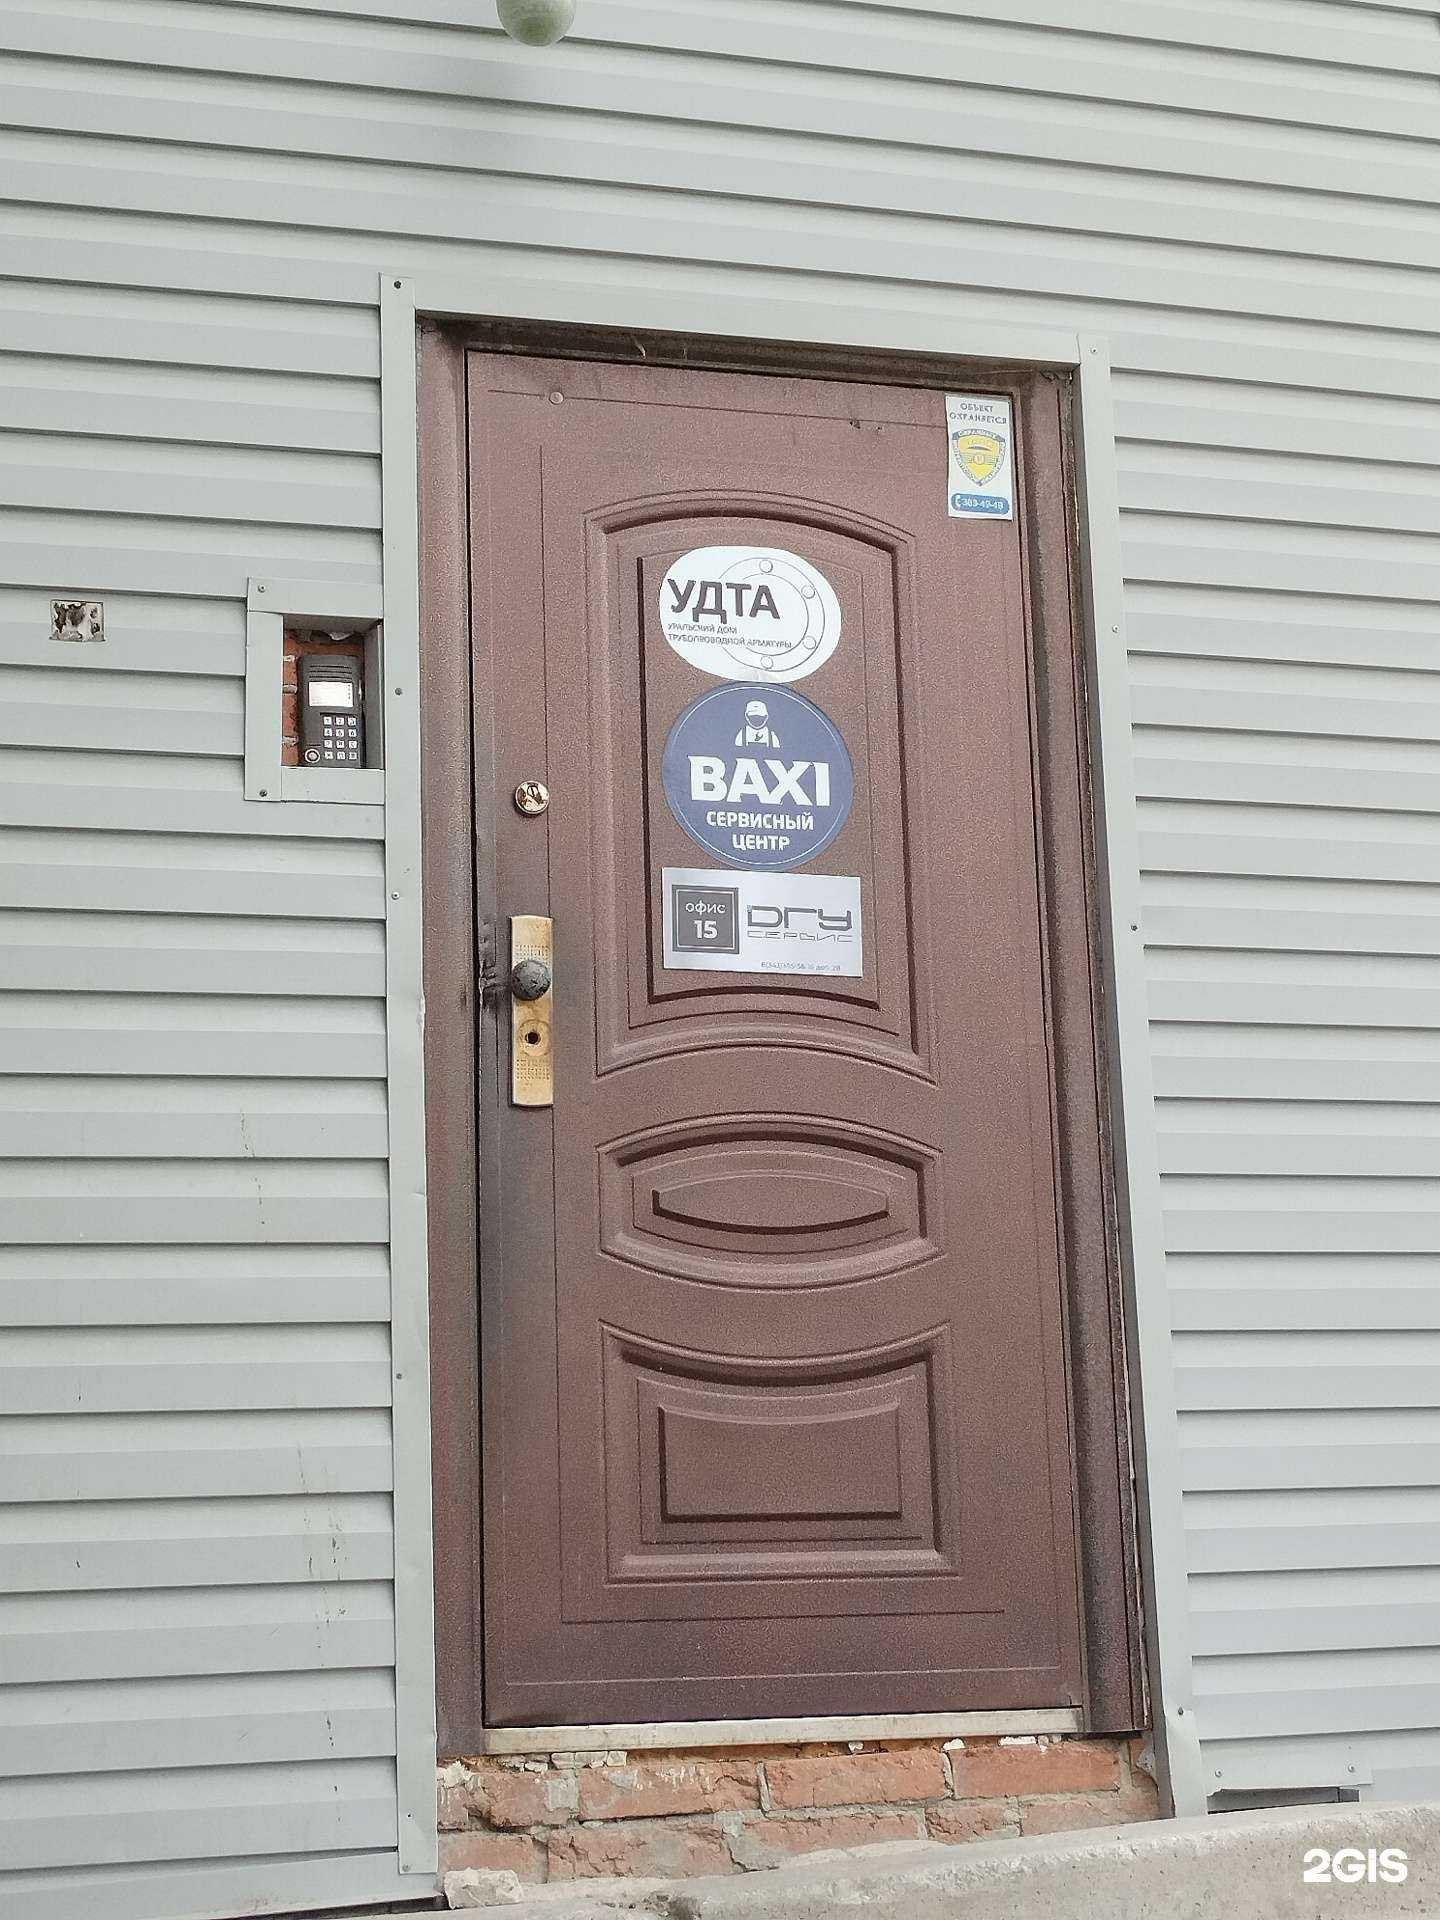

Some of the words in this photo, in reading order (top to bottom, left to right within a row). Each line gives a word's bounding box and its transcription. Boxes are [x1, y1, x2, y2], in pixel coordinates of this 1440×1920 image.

[960, 403, 993, 413] ОБЪЕКТ
[949, 412, 1007, 424] ОХРАНЯЕТСЯ
[667, 578, 780, 624] УДТА
[668, 622, 715, 633] УРАЛЬСКИЙ
[716, 625, 737, 634] ДОМ
[668, 633, 745, 645] ТРУБОПРОВОДНОЙ
[746, 639, 792, 648] АРМАТУРЫ
[687, 755, 830, 807] BAXI
[706, 811, 815, 831] СЕРВИСНЫЙ
[732, 833, 791, 851] ЦЕНТР
[694, 920, 718, 939] 15
[747, 930, 853, 943] СЕРВИС
